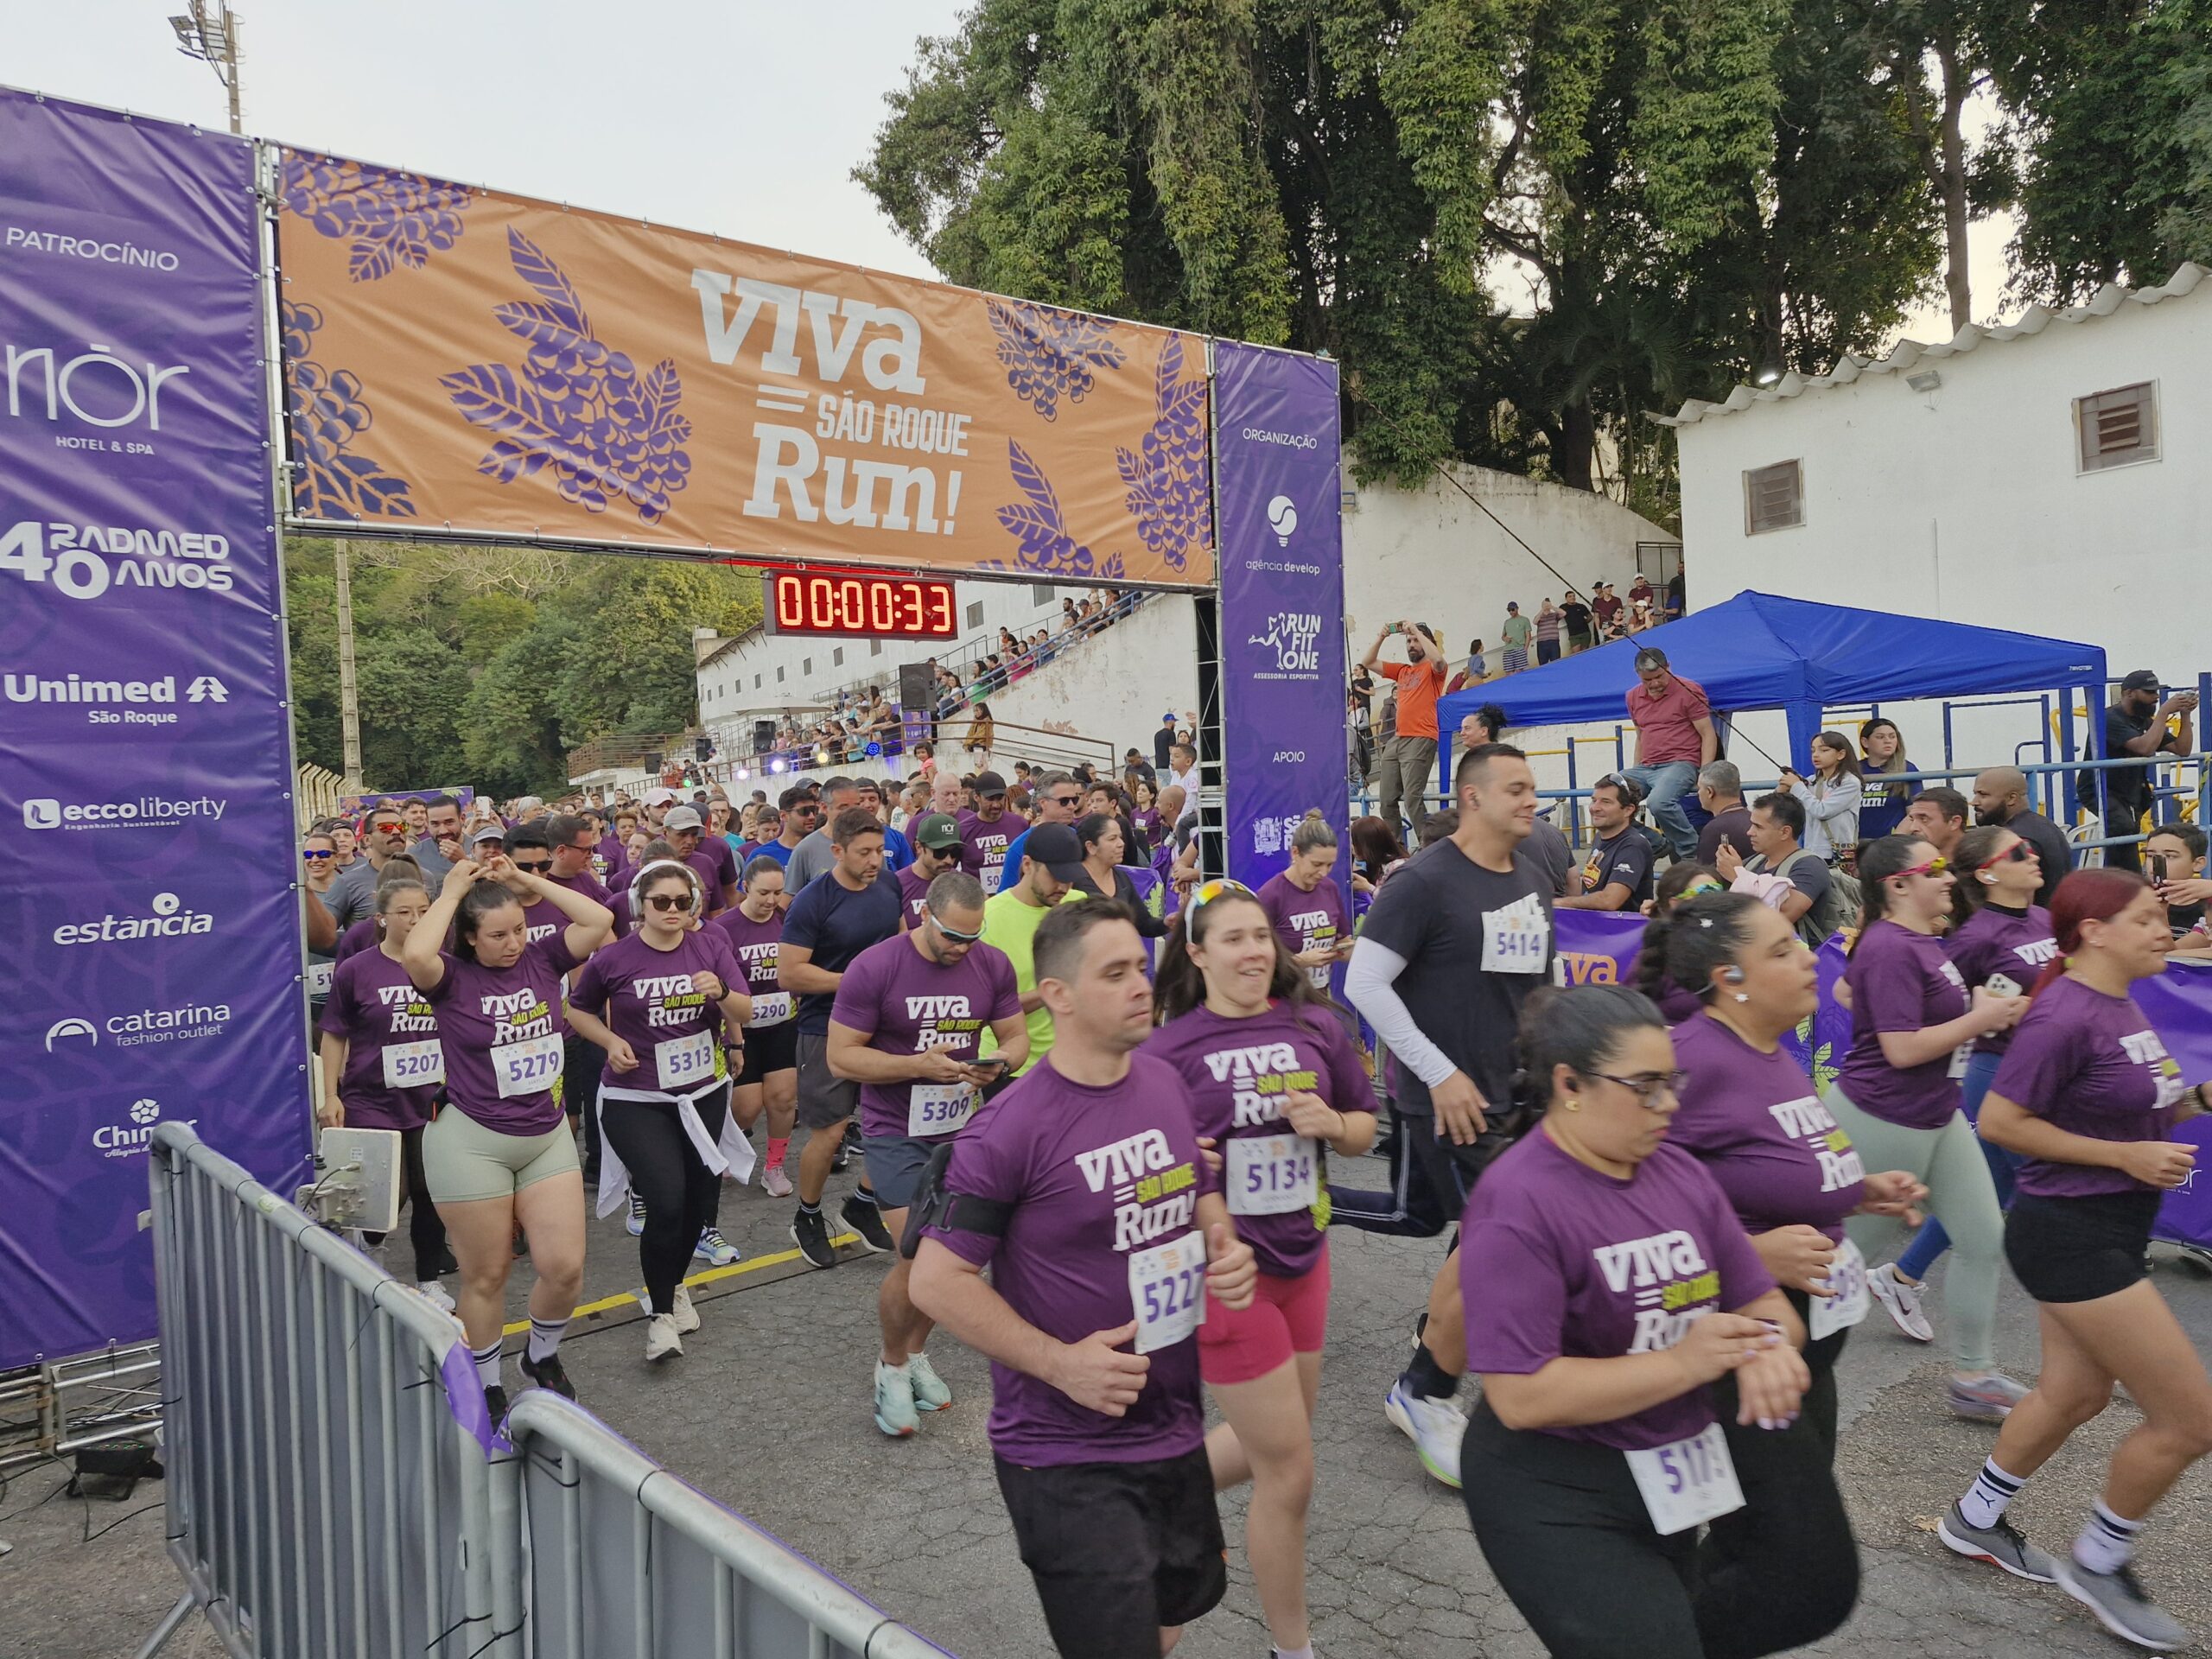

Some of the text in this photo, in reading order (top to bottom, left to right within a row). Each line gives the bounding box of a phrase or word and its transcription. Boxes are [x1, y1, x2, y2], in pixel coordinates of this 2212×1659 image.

[6, 226, 179, 271] PATROCÍNIO
[817, 389, 972, 457] SÃO ROQUE
[55, 435, 155, 456] HOTEL & SPA
[1243, 427, 1318, 450] ORGANIZAÇÃO
[742, 422, 963, 536] Run!
[49, 522, 230, 560] RADMED
[0, 521, 110, 600] 40
[1245, 559, 1320, 576] agência develop
[115, 560, 234, 591] ANOS
[778, 575, 951, 632] 00:00:33
[1287, 613, 1321, 633] RUN
[1291, 632, 1317, 652] FIT
[1282, 651, 1319, 670] ONE
[4, 674, 176, 703] Unimed
[88, 710, 179, 727] São Roque
[1272, 751, 1306, 764] APOIO
[1862, 798, 1887, 807] un!
[65, 823, 120, 831] Engenharia
[987, 875, 1002, 886] 50
[53, 909, 214, 945] estância
[1497, 931, 1541, 957] 5414
[317, 972, 332, 986] 51
[105, 1002, 232, 1035] catarina
[648, 1006, 704, 1027] Run!
[116, 1023, 225, 1047] fashion outlet
[492, 1014, 553, 1046] Run!
[396, 1052, 440, 1077] 5207
[509, 1051, 560, 1082] 5279
[670, 1046, 711, 1074] 5313
[922, 1096, 969, 1122] 5309
[1247, 1155, 1311, 1192] 5134
[1112, 1189, 1197, 1252] Run!
